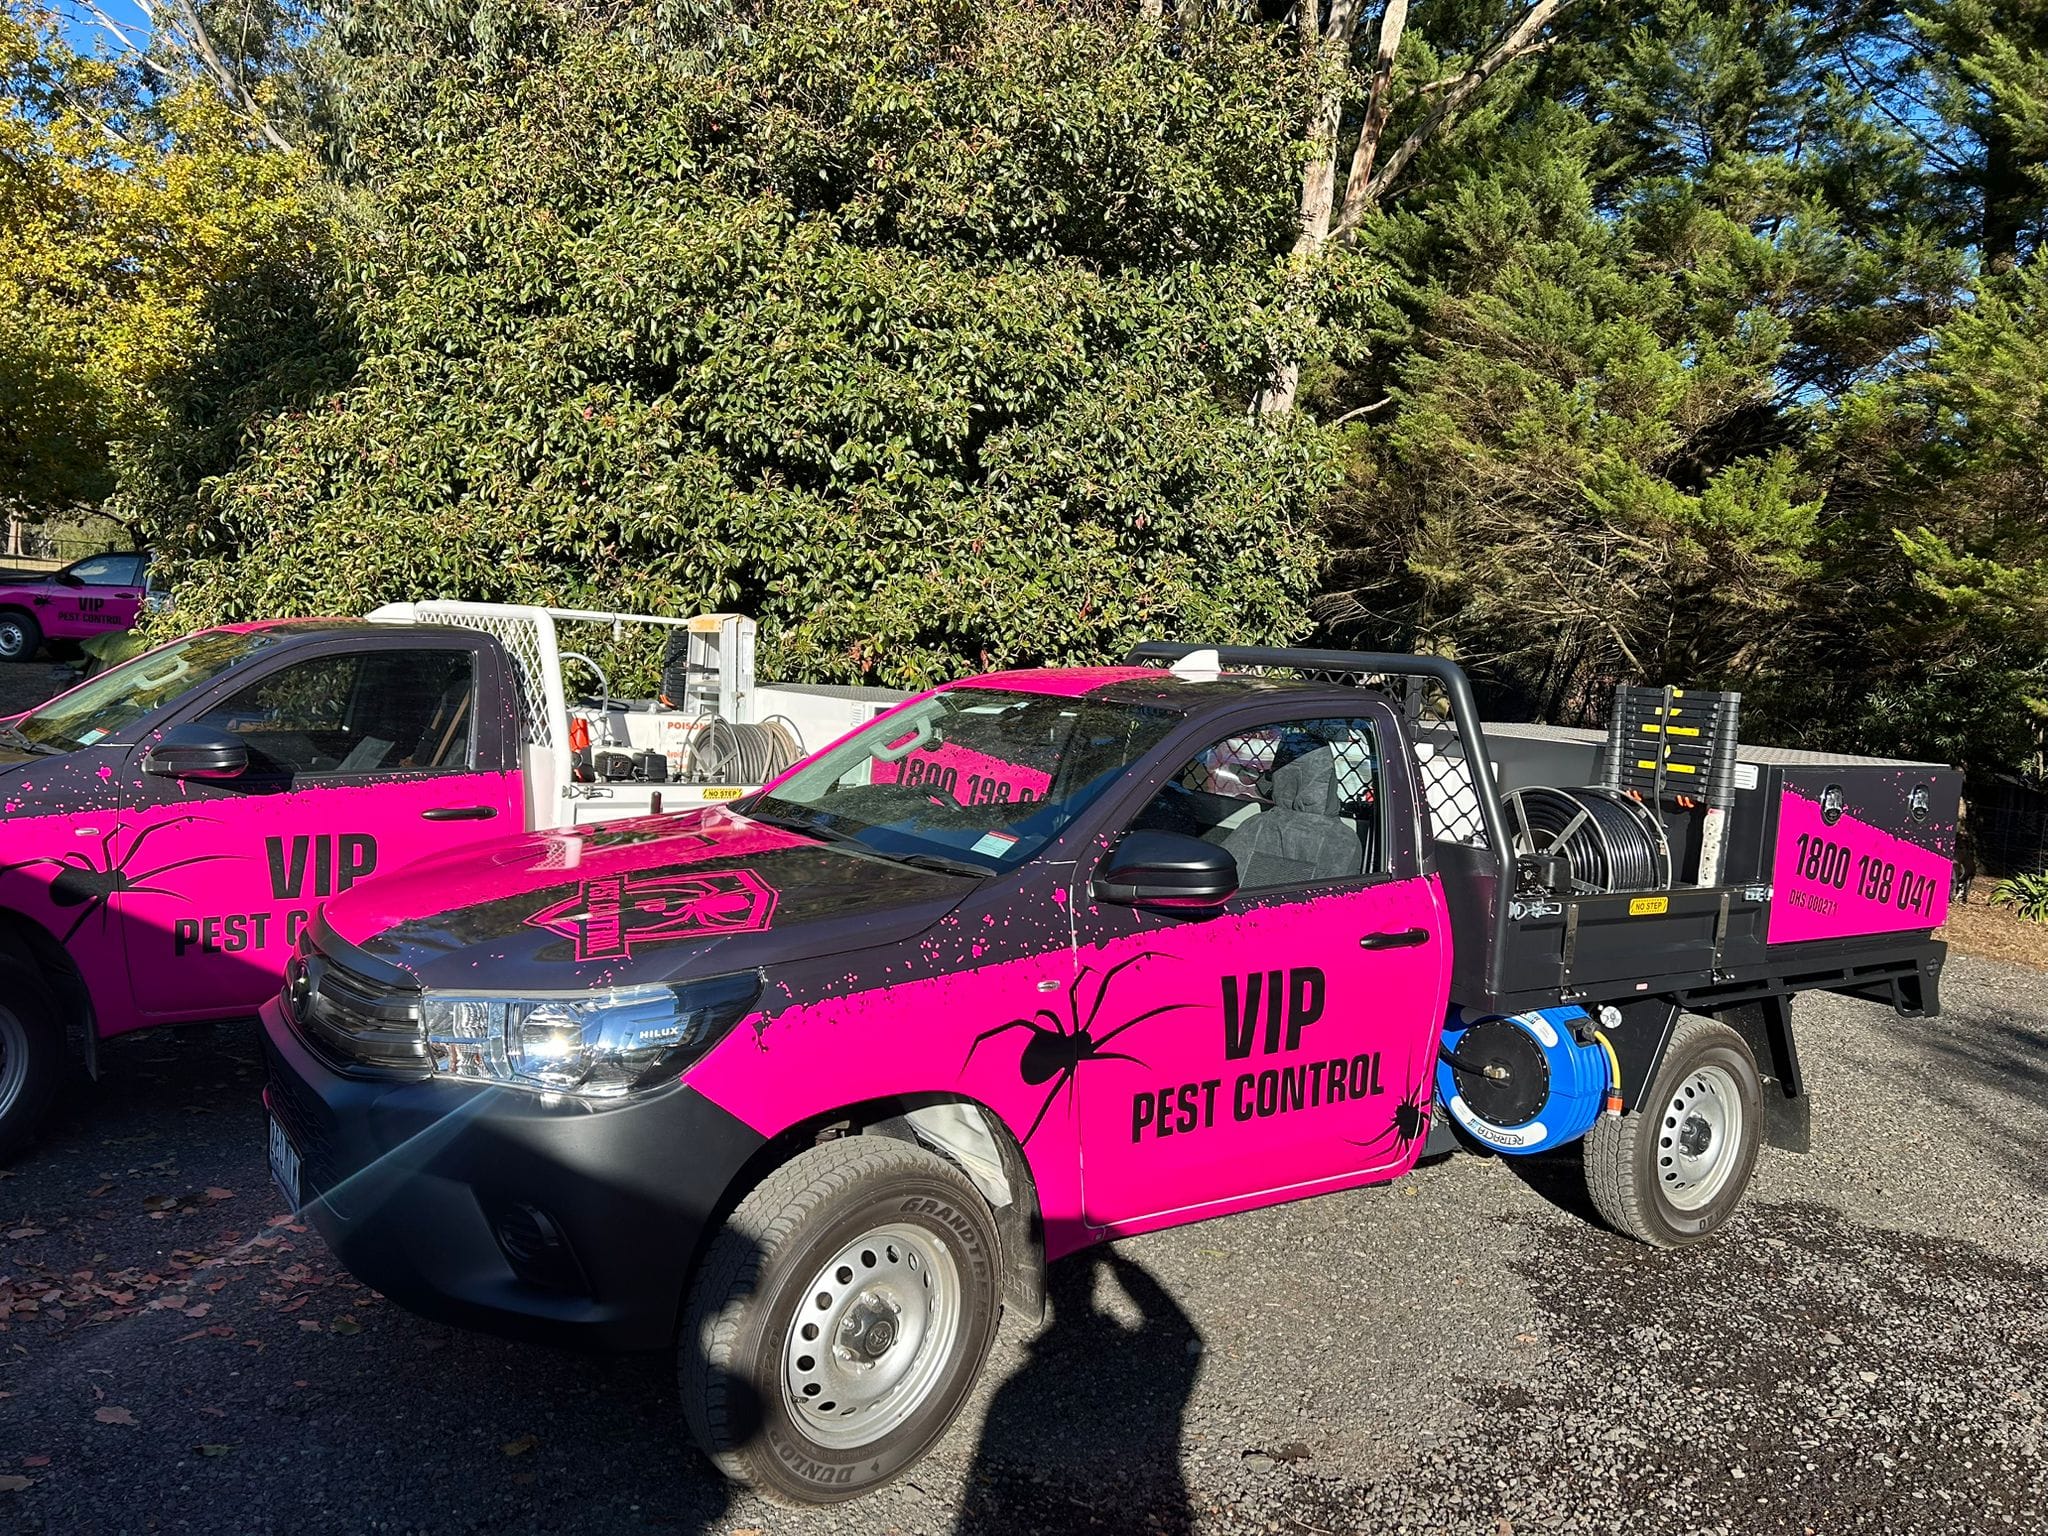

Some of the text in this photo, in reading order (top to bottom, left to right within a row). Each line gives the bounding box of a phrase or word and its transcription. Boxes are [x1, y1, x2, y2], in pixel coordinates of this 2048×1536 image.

[58, 611, 122, 624] PEST CONTROL
[79, 597, 104, 611] VIP
[264, 833, 378, 899] VIP
[1796, 833, 1937, 918] 1800 198 041
[1636, 902, 1662, 910] NO STEP
[1789, 888, 1838, 917] DHS 000271
[174, 912, 272, 956] PEST
[639, 1026, 679, 1039] HILUX
[1221, 966, 1325, 1060] VIP
[1132, 1052, 1384, 1144] PEST CONTROL
[769, 1429, 856, 1483] DUNLOP
